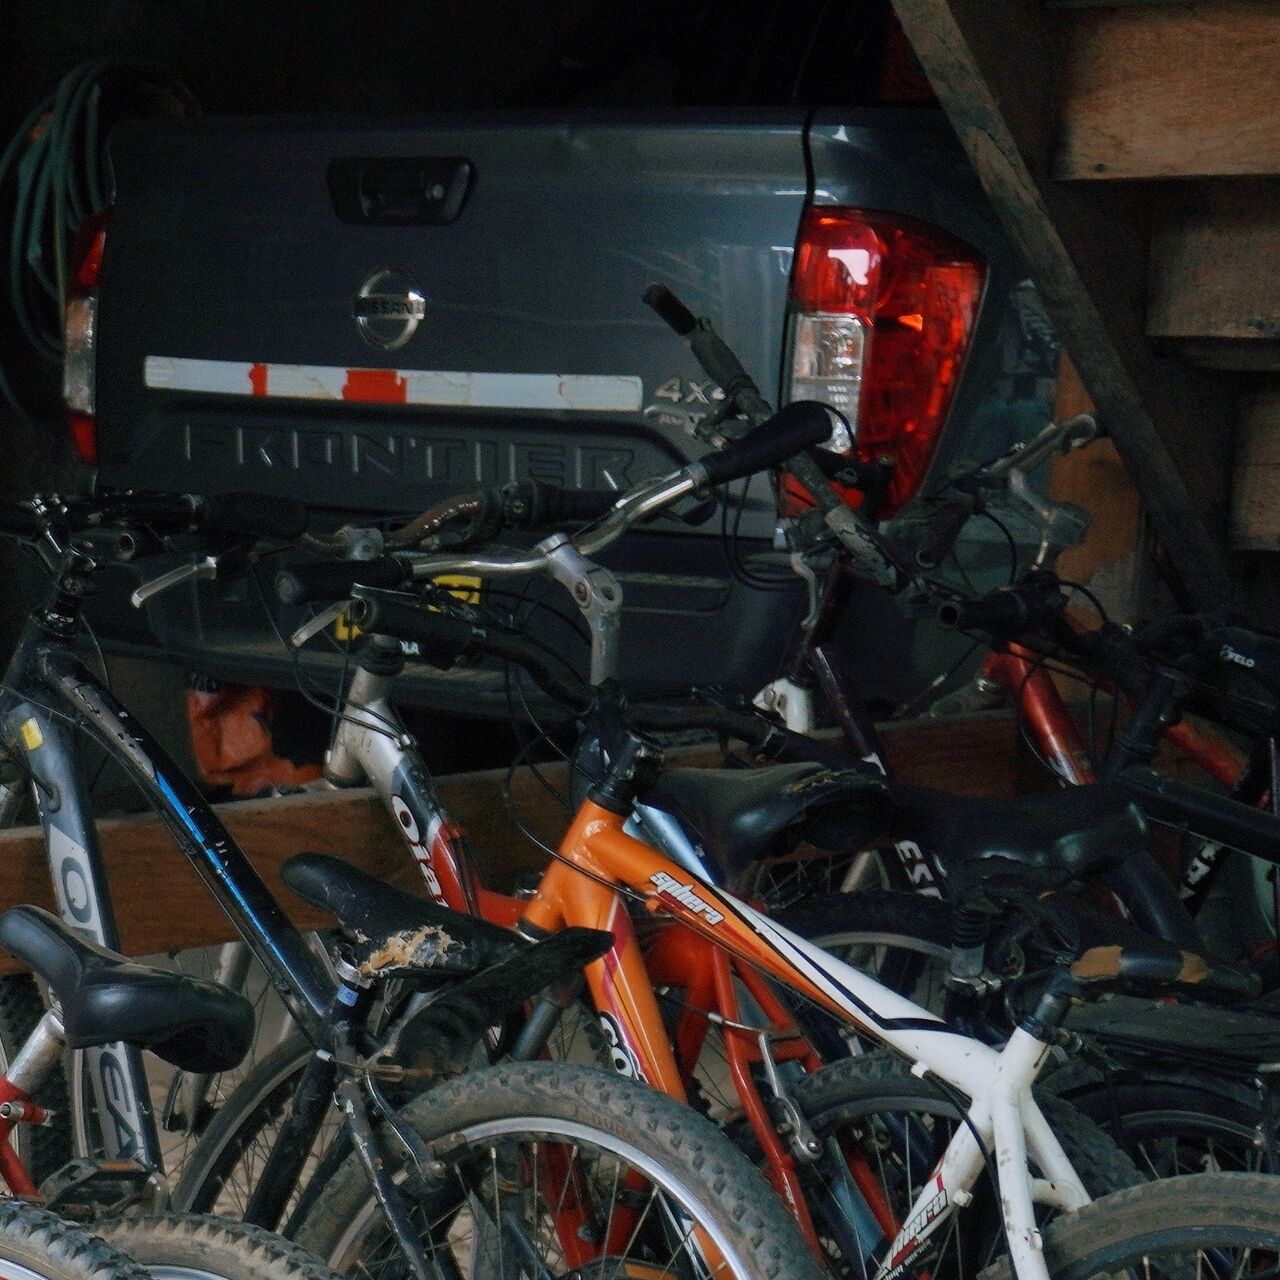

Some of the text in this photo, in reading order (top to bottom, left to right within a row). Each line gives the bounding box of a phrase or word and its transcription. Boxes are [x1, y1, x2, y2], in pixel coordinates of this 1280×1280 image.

[184, 424, 636, 490] FRONTIER
[649, 871, 724, 926] sphera
[56, 856, 145, 1158] OEA
